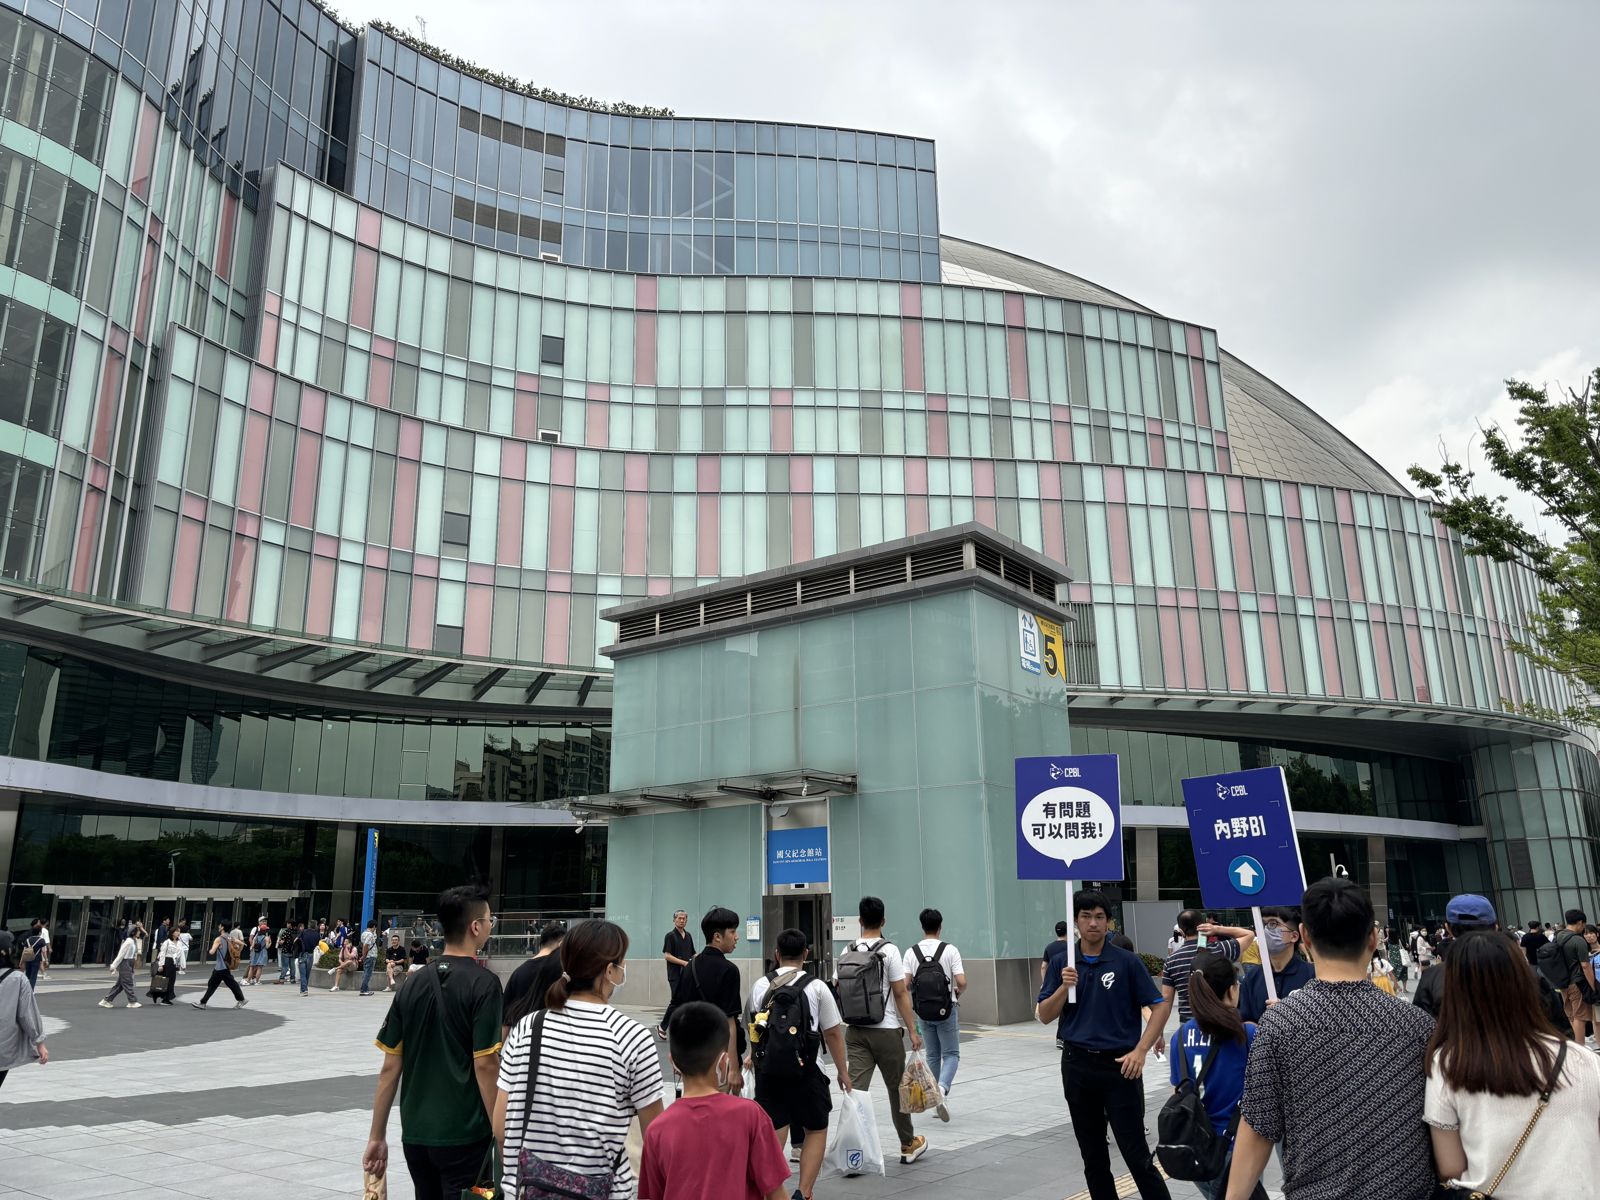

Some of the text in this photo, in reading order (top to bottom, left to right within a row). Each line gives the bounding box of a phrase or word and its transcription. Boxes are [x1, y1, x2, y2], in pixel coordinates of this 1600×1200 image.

[1044, 634, 1058, 676] 5
[1064, 767, 1081, 778] CPBL
[1230, 784, 1248, 796] CPBL
[1042, 801, 1091, 819] 有問題
[1031, 821, 1103, 840] 可以問我!
[776, 847, 822, 859] 國父紀念館站
